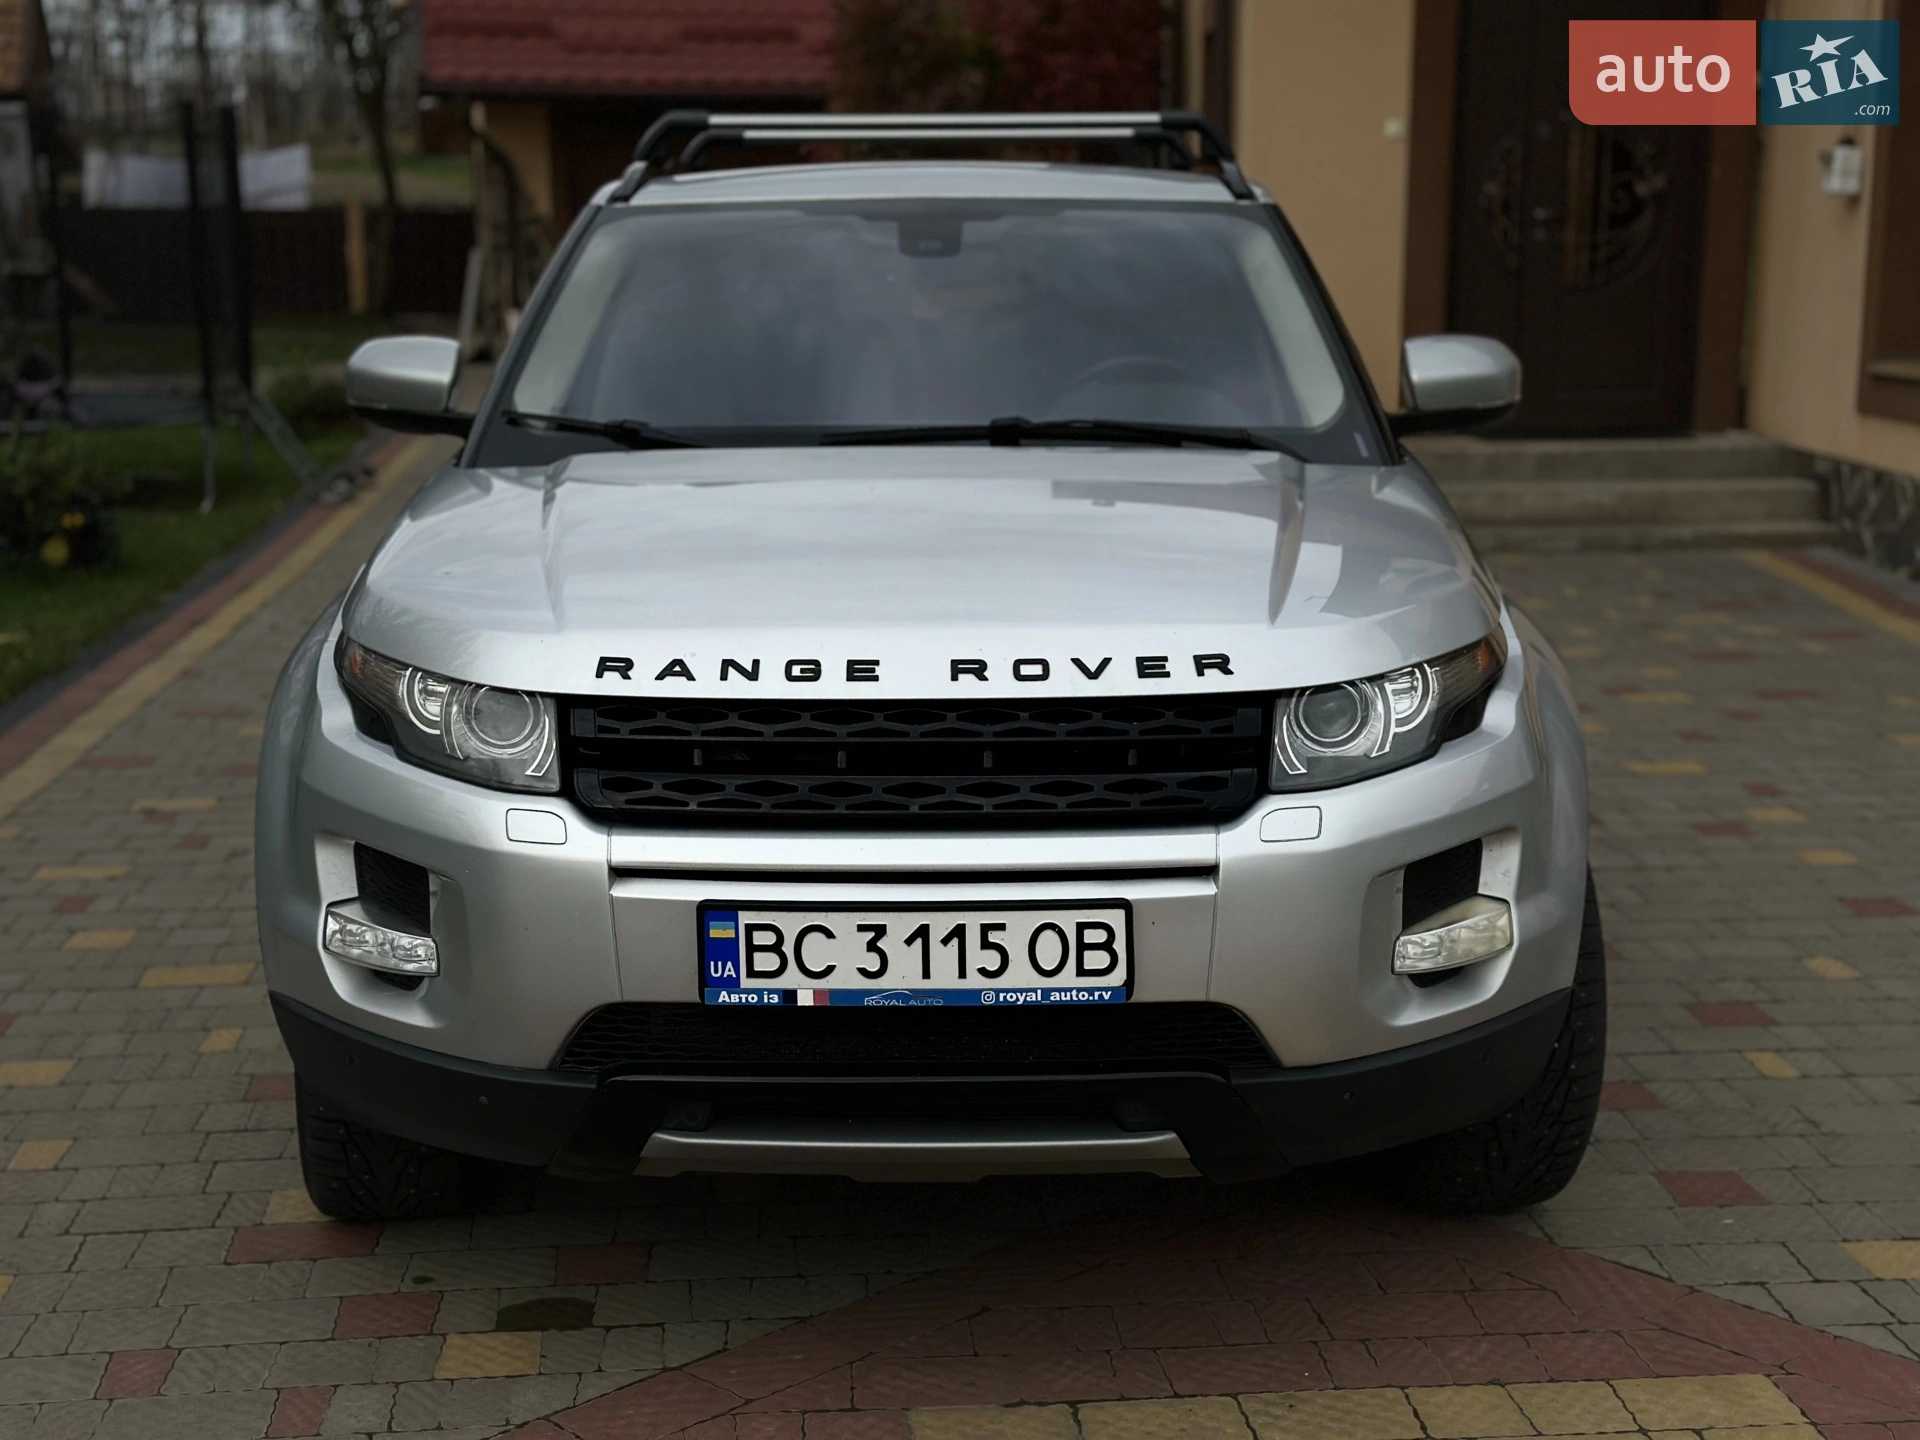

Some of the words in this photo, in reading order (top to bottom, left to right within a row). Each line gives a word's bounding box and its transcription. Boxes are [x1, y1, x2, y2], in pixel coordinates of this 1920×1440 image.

[595, 656, 881, 682] RANGE
[950, 653, 1234, 682] ROVER
[744, 922, 837, 979] BC
[855, 922, 1011, 979] 3115
[1027, 921, 1119, 978] OB
[710, 961, 737, 978] UA
[718, 991, 758, 1004] Авто
[763, 991, 779, 1004] із
[864, 998, 906, 1006] ROYAL
[908, 998, 944, 1006] AUTO
[999, 989, 1112, 1005] royal_auto.rv
